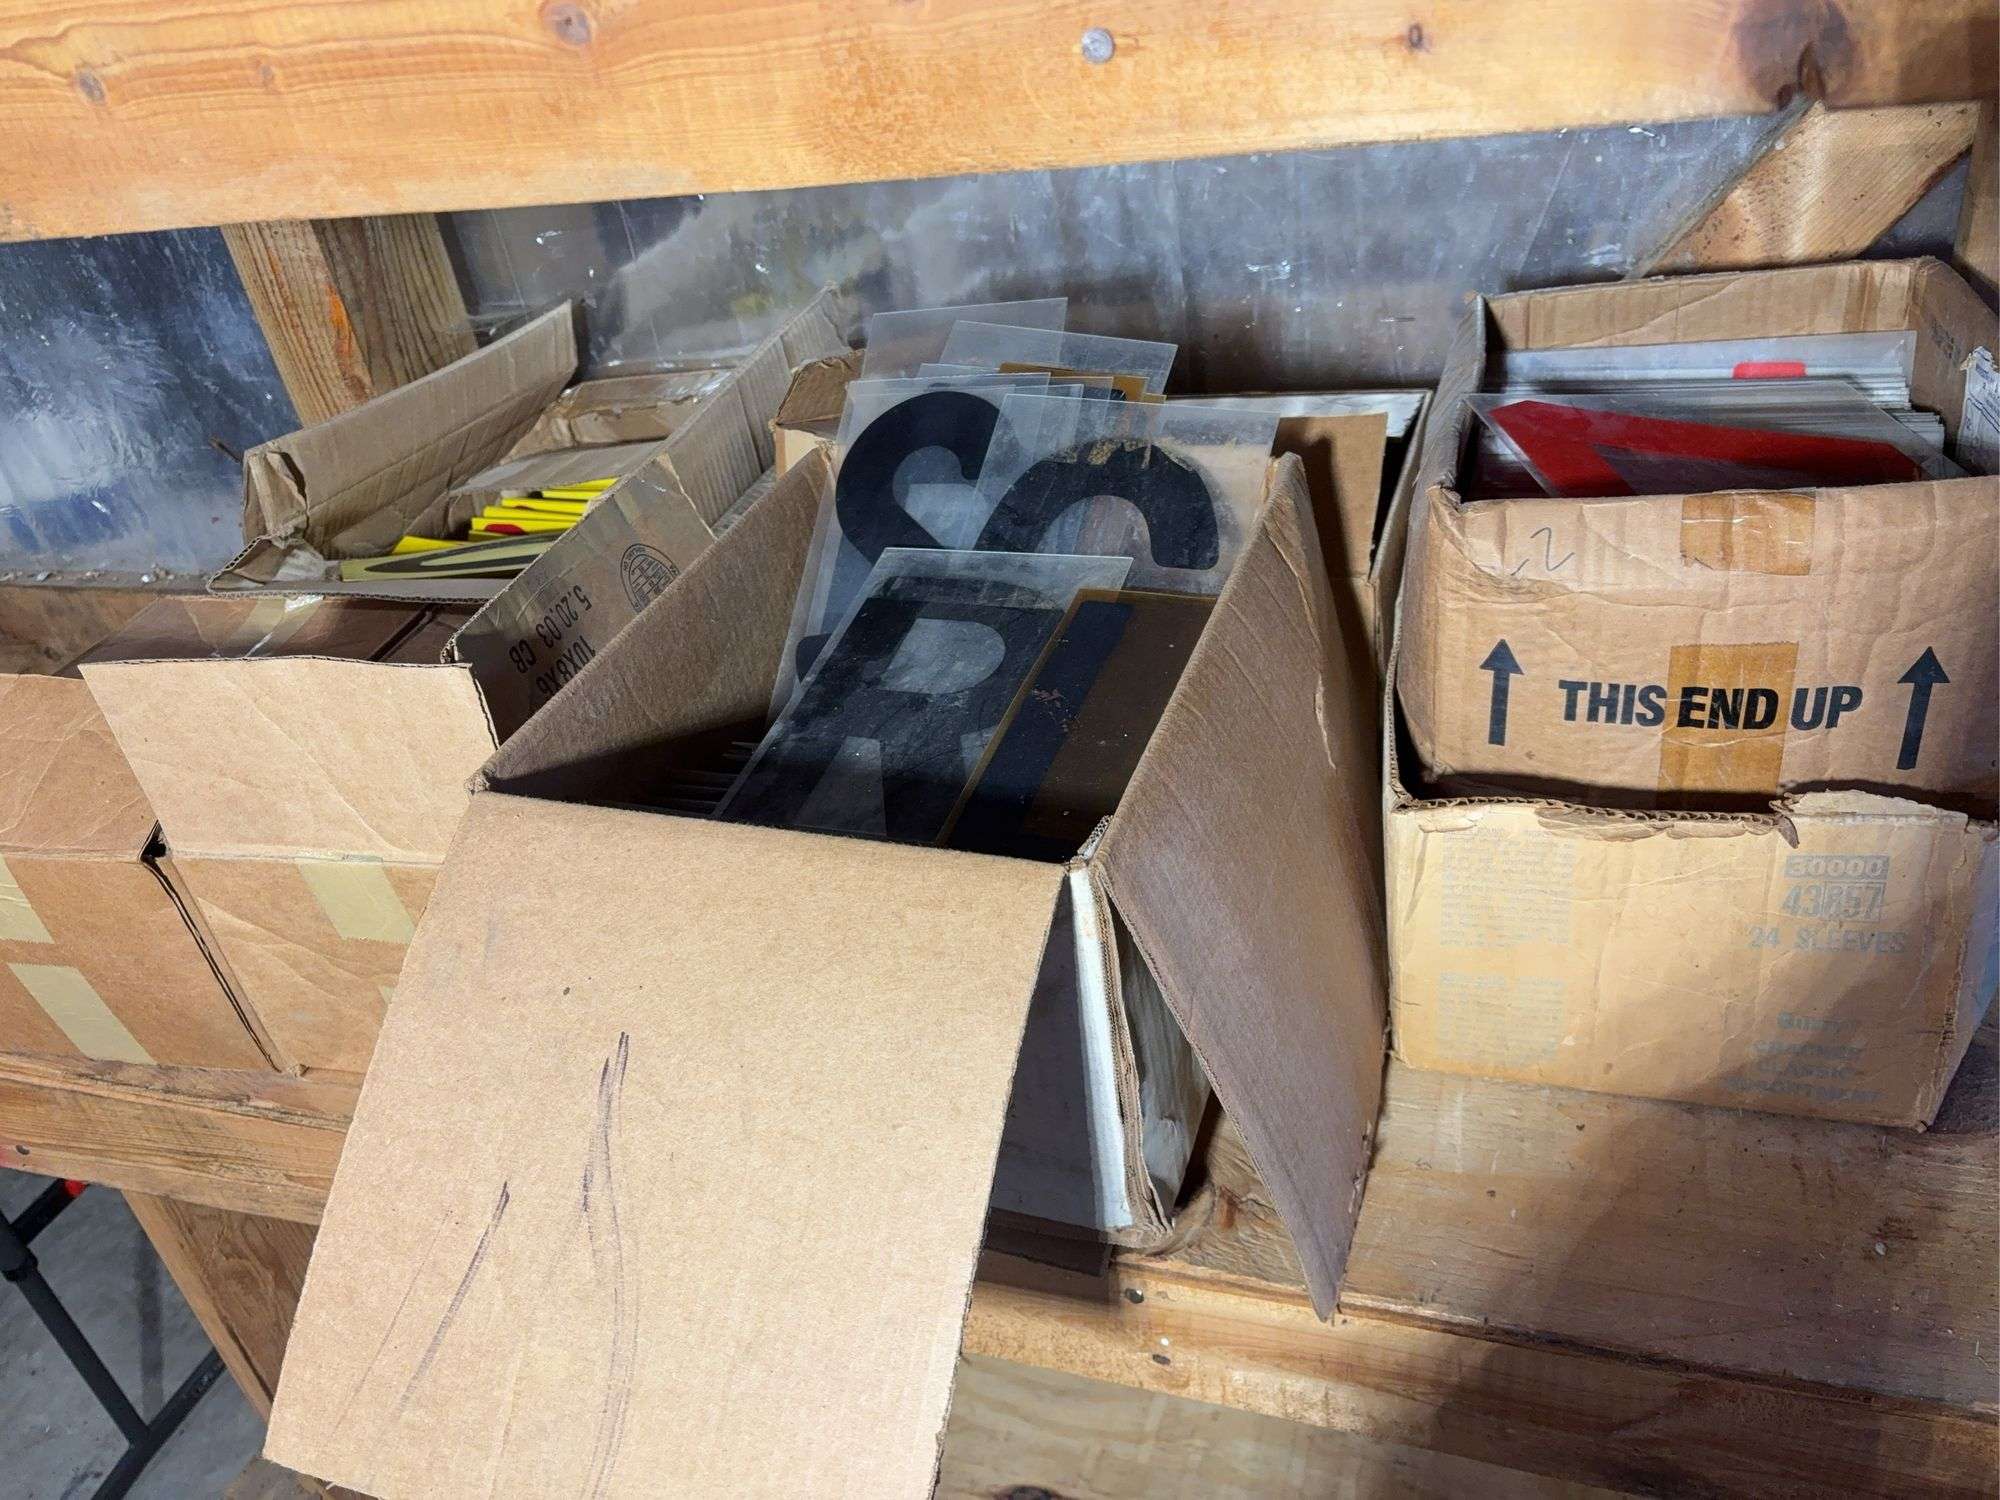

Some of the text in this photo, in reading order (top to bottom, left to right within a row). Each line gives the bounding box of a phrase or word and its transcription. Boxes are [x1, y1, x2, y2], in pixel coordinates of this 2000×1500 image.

[509, 584, 593, 674] 5.20.03 CB
[1558, 679, 1864, 731] THIS END UP
[1794, 927, 1906, 953] SLEEVES
